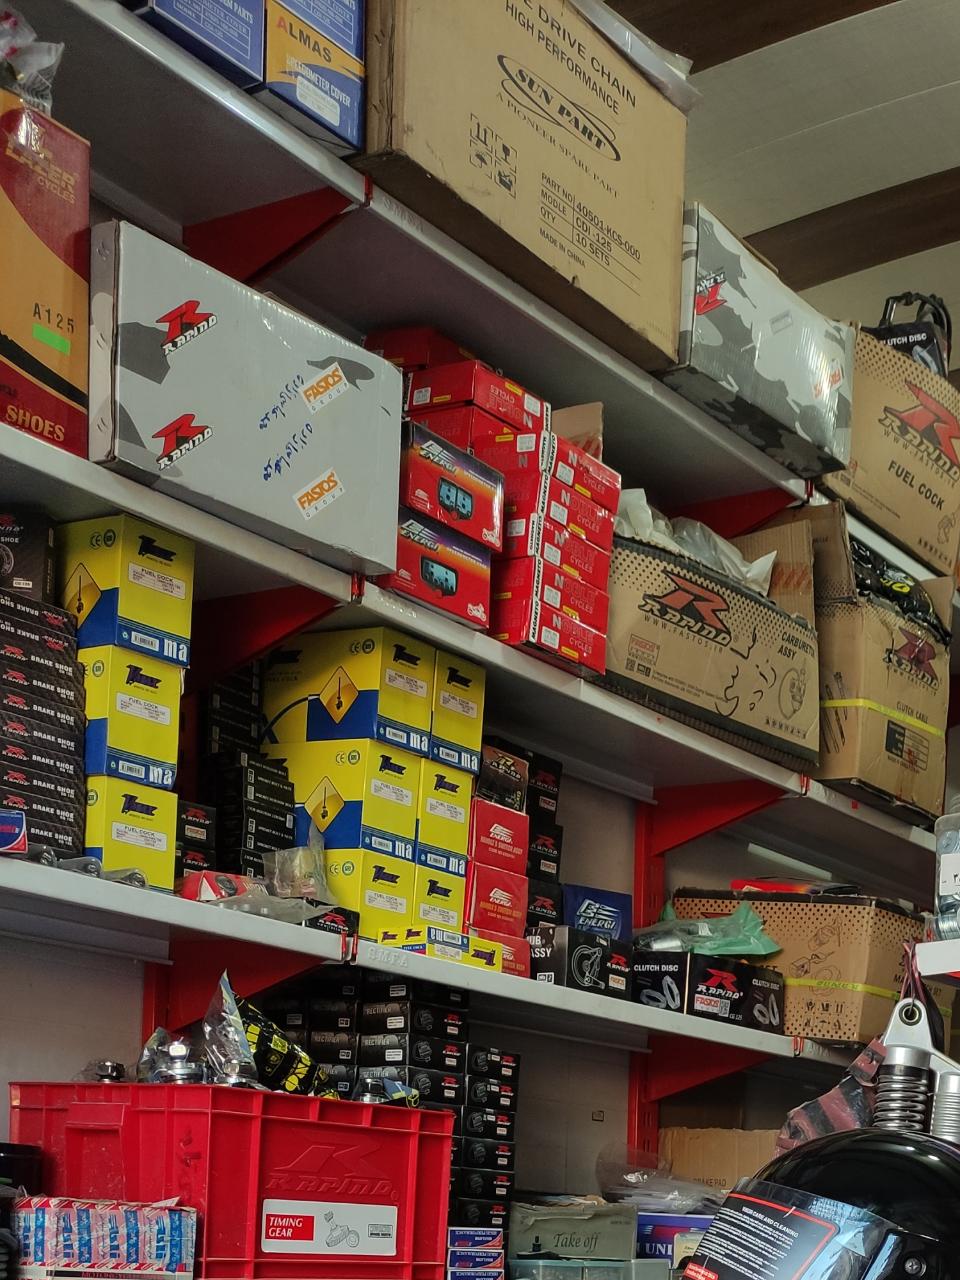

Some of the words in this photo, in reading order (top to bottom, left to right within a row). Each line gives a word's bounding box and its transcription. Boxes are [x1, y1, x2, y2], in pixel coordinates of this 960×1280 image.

[275, 15, 333, 64] ALMAS
[504, 2, 536, 40] HIGH
[537, 27, 621, 116] PERFORMANCE
[537, 6, 587, 60] DRIVE
[590, 55, 638, 108] CHAIN
[329, 86, 351, 108] COVER
[514, 67, 555, 107] SUN
[557, 101, 607, 152] PART
[558, 142, 592, 179] SPARE
[591, 173, 621, 199] PART
[37, 178, 76, 204] CYCLES
[540, 172, 563, 195] PART
[540, 189, 567, 217] MODLE
[539, 226, 559, 249] MADE
[558, 242, 568, 255] IN
[567, 246, 587, 269] CHINA
[540, 206, 557, 225] QTY
[575, 233, 588, 249] 10
[588, 241, 611, 267] SETS
[303, 365, 344, 404] FASTOS
[5, 404, 66, 442] SHOES
[419, 450, 456, 474] ENERGI
[297, 471, 339, 511] FASTOS
[540, 474, 549, 514] MAGNETO
[888, 460, 914, 486] FUEL
[916, 481, 945, 511] COCK
[400, 529, 439, 552] ENERGI
[140, 568, 157, 579] FUEL
[570, 555, 593, 574] CYCLES
[534, 559, 542, 598] MAGNETO
[570, 596, 593, 614] CYCLES
[531, 600, 539, 641] MAGNETO
[163, 638, 188, 662] ma
[569, 636, 593, 654] CYCLES
[777, 645, 797, 660] ASSY
[30, 655, 53, 667] BRAKE
[55, 662, 73, 673] SHOE
[32, 680, 55, 691] BRAKE
[56, 687, 75, 698] SHOE
[32, 704, 55, 716] BRAKE
[56, 711, 75, 722] SHOE
[33, 731, 56, 742] BRAKE
[57, 737, 75, 748] SHOE
[409, 731, 429, 752] ma
[31, 755, 54, 766] BRAKE
[56, 761, 74, 771] SHOE
[460, 751, 479, 771] ma
[149, 764, 172, 786] ma
[124, 825, 139, 834] FUEL
[394, 839, 413, 860] ma
[449, 855, 466, 876] ma
[578, 915, 616, 931] ENERGI
[633, 963, 661, 973] CLUTCH
[662, 964, 679, 972] DISC
[268, 1216, 303, 1228] TIMING
[268, 1227, 294, 1239] GEAR
[552, 1231, 583, 1250] Take
[583, 1231, 601, 1250] off
